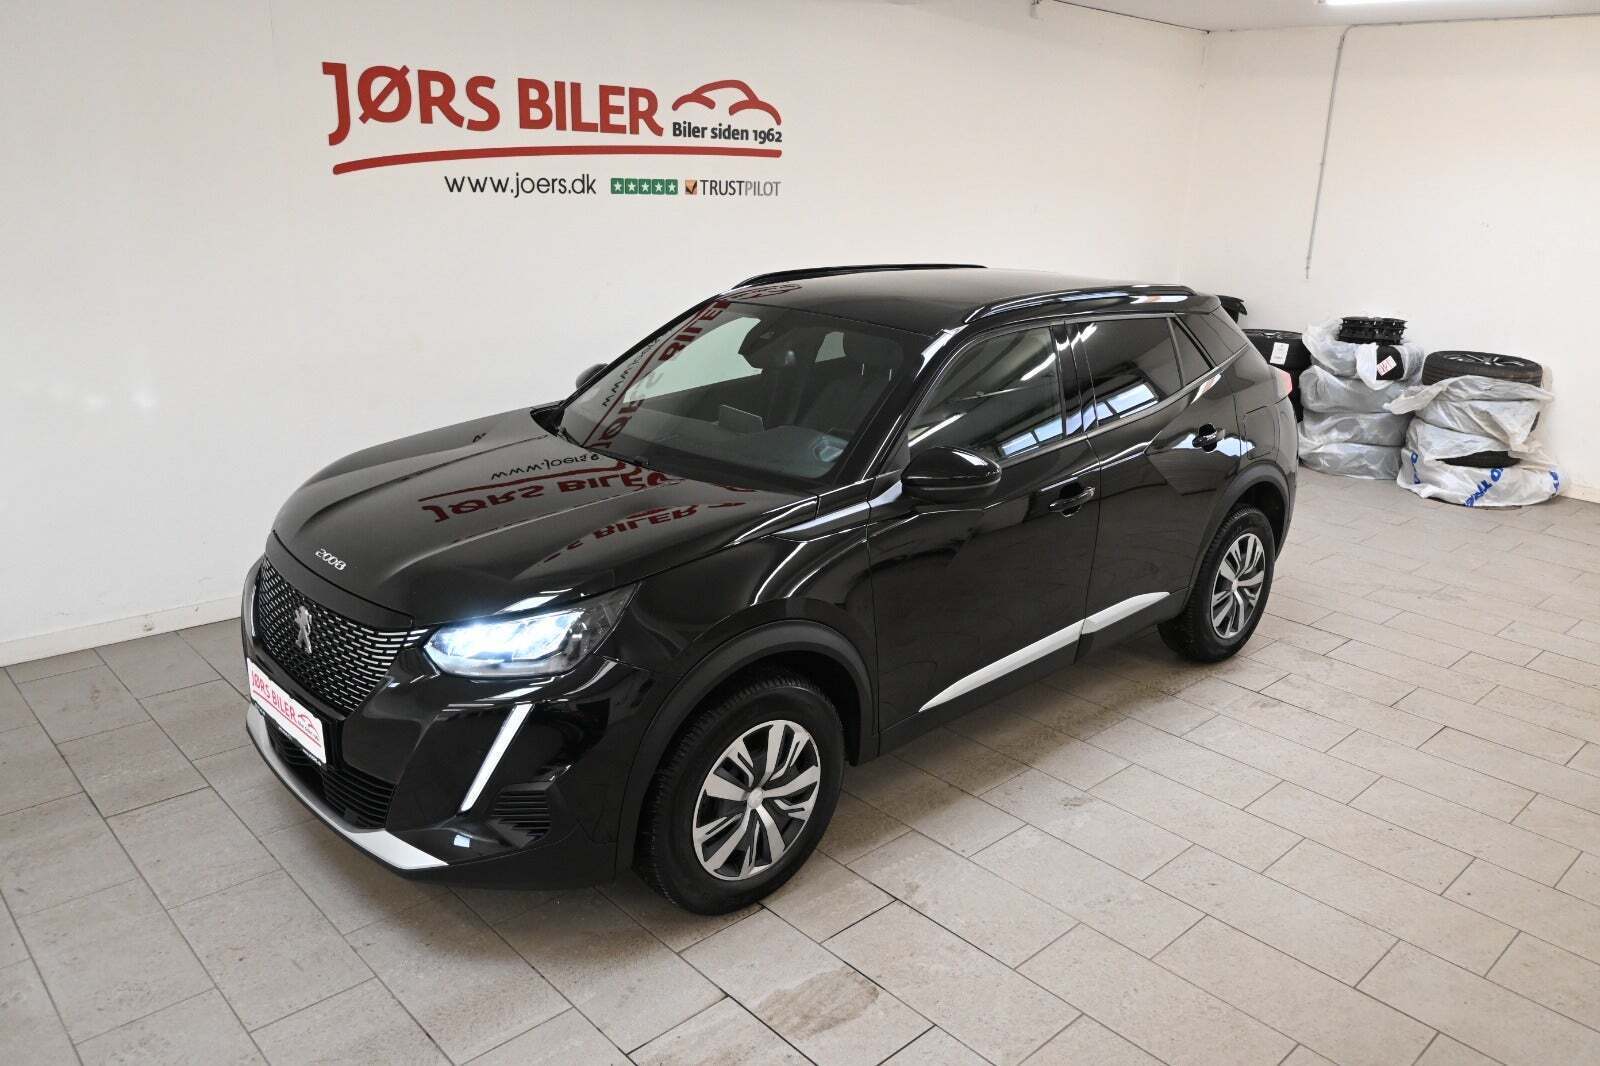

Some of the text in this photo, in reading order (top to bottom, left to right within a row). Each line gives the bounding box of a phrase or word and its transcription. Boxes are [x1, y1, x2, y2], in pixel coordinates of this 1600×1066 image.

[322, 61, 665, 146] JØRS BILER
[672, 121, 783, 144] Biler siden 1962
[444, 172, 597, 198] www.joers.dk
[699, 179, 781, 197] TRUSTPILOT
[315, 548, 347, 571] 2008
[270, 690, 301, 726] BILER
